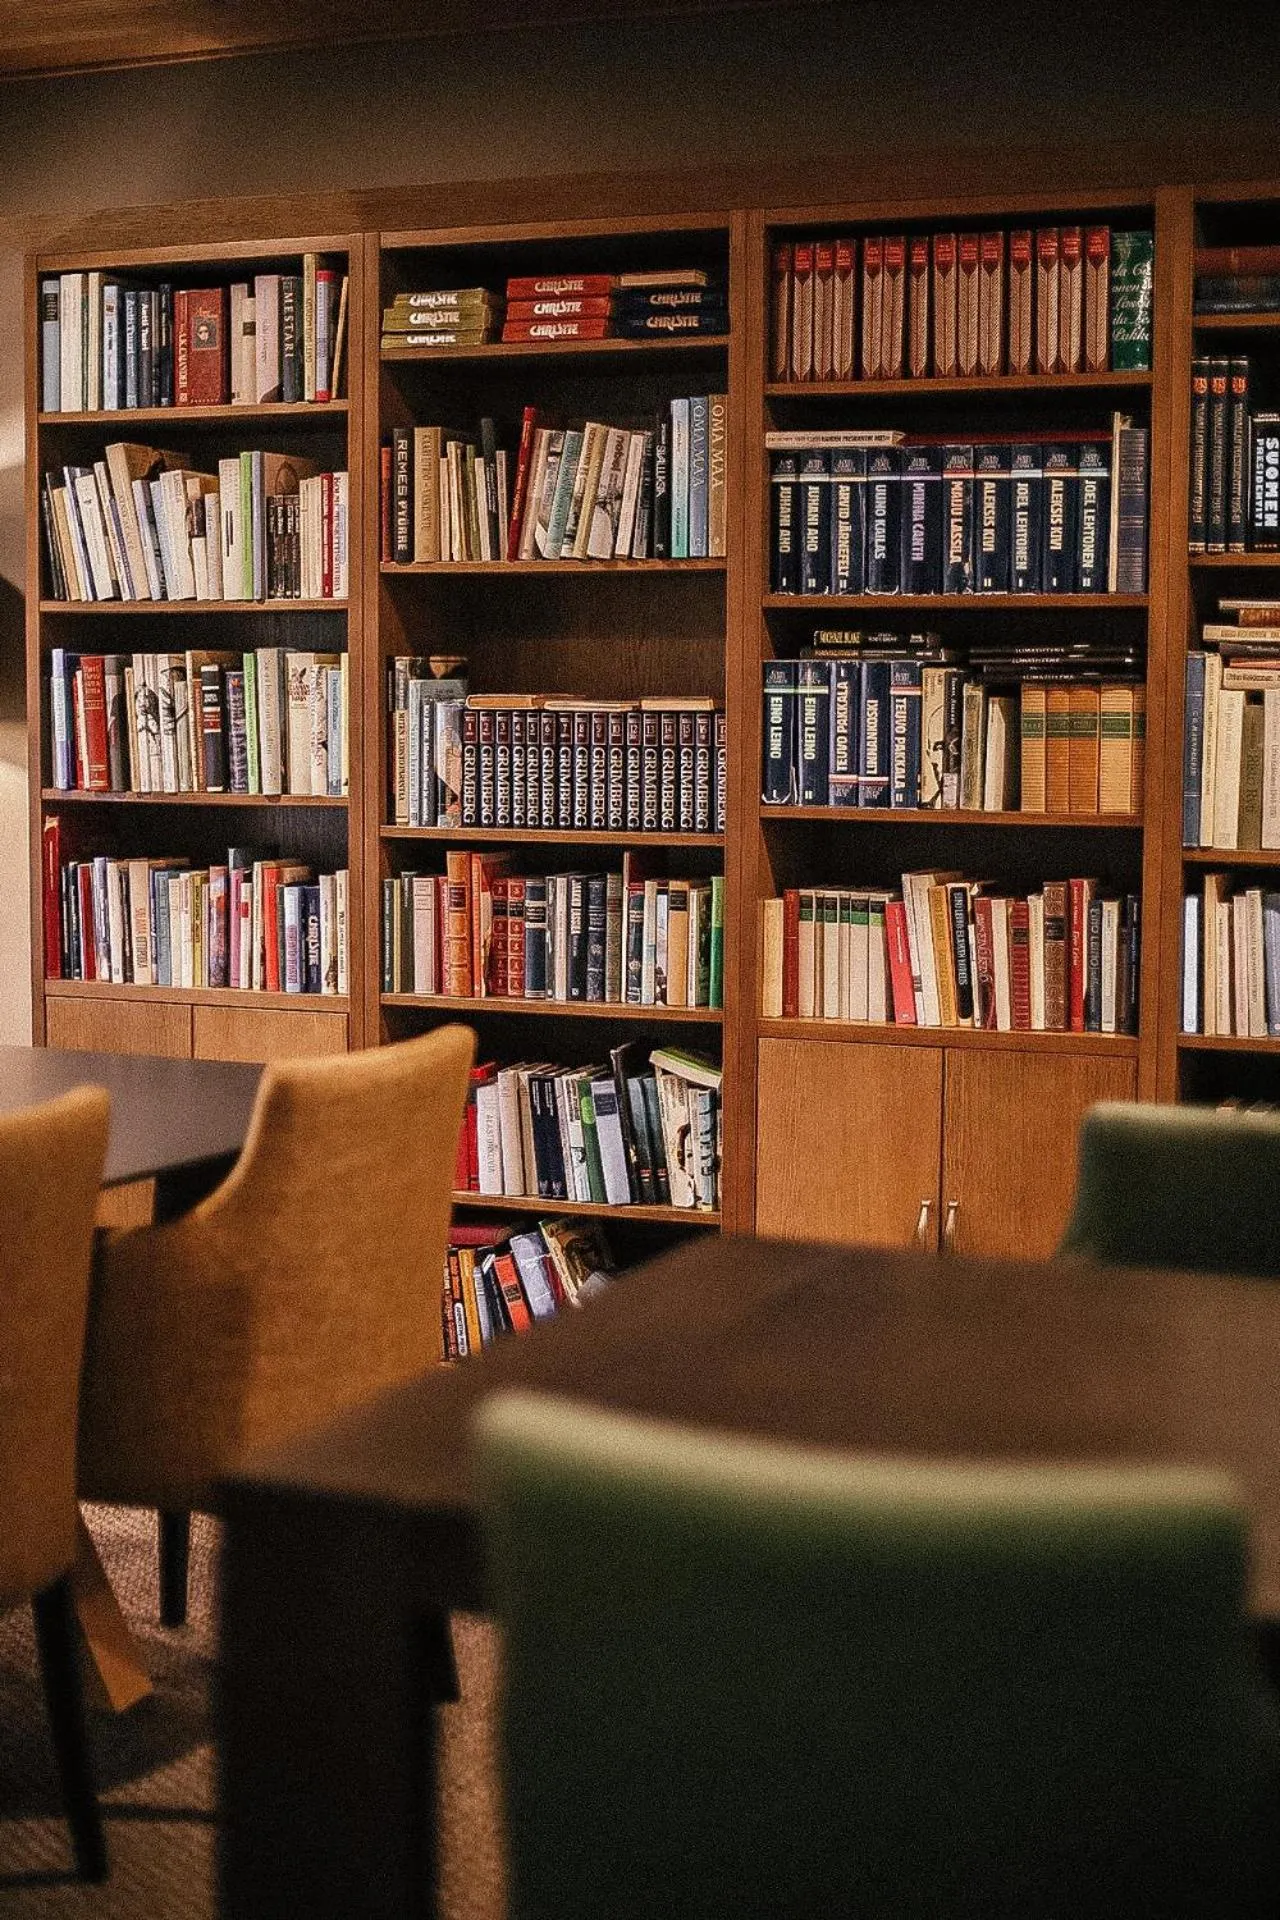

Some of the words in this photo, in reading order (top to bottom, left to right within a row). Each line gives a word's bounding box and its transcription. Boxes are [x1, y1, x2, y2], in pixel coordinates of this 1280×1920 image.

[409, 293, 458, 308] CHRISTIE
[534, 279, 584, 295] CHRISTIE
[650, 291, 701, 306] CHRISTIE
[284, 292, 294, 358] MESTARI
[409, 311, 460, 327] CHRISTIE
[533, 301, 582, 316] CHRISTIE
[646, 314, 699, 331] CHRISTIE
[529, 323, 579, 339] CHRISTIE
[694, 405, 705, 444] OMA
[713, 405, 723, 444] OMA
[398, 439, 407, 496] REMES
[693, 449, 704, 488] MAA
[712, 448, 723, 489] MAA
[1264, 437, 1279, 527] SUOMEN
[780, 486, 790, 526] JUHANI
[808, 486, 819, 525] JUHANI
[838, 485, 850, 518] ARVID
[875, 485, 886, 516] UUNO
[912, 483, 924, 521] MINNA
[951, 481, 963, 516] MAIJU
[984, 482, 995, 526] ALEKSIS
[1017, 483, 1028, 508] JOEL
[1051, 480, 1063, 524] ALEKSIS
[1084, 480, 1096, 506] JOEL
[779, 529, 790, 553] AHO
[807, 528, 818, 552] AHO
[838, 520, 851, 577] JÄRNEFELT
[875, 519, 885, 559] KAILAS
[911, 524, 924, 561] CANTH
[950, 518, 962, 563] LASSILA
[983, 529, 994, 551] KIVI
[1016, 512, 1028, 570] LEHTONEN
[1050, 527, 1062, 550] KIVI
[1082, 509, 1095, 568] LEHTONEN
[771, 696, 782, 724] EINO
[805, 697, 816, 725] EINO
[837, 682, 848, 733] PAKKALA
[895, 698, 906, 734] TEUVO
[771, 727, 782, 759] LEINO
[804, 727, 816, 760] LEINO
[837, 736, 848, 771] TEUVO
[866, 700, 878, 775] LINNANKOSKI
[895, 737, 906, 788] PAKKALA
[464, 745, 475, 823] GRIMBERG
[481, 745, 492, 824] GRIMBERG
[498, 745, 508, 824] GRIMBERG
[513, 746, 523, 824] GRIMBERG
[527, 746, 538, 825] GRIMBERG
[543, 747, 553, 826] GRIMBERG
[560, 747, 570, 826] GRIMBERG
[576, 747, 587, 826] GRIMBERG
[593, 747, 604, 826] GRIMBERG
[610, 747, 622, 827] GRIMBERG
[628, 747, 639, 828] GRIMBERG
[644, 748, 656, 828] GRIMBERG
[662, 748, 673, 828] GRIMBERG
[680, 748, 692, 828] GRIMBERG
[697, 748, 708, 829] GRIMBERG
[306, 915, 319, 965] CHRISTIE
